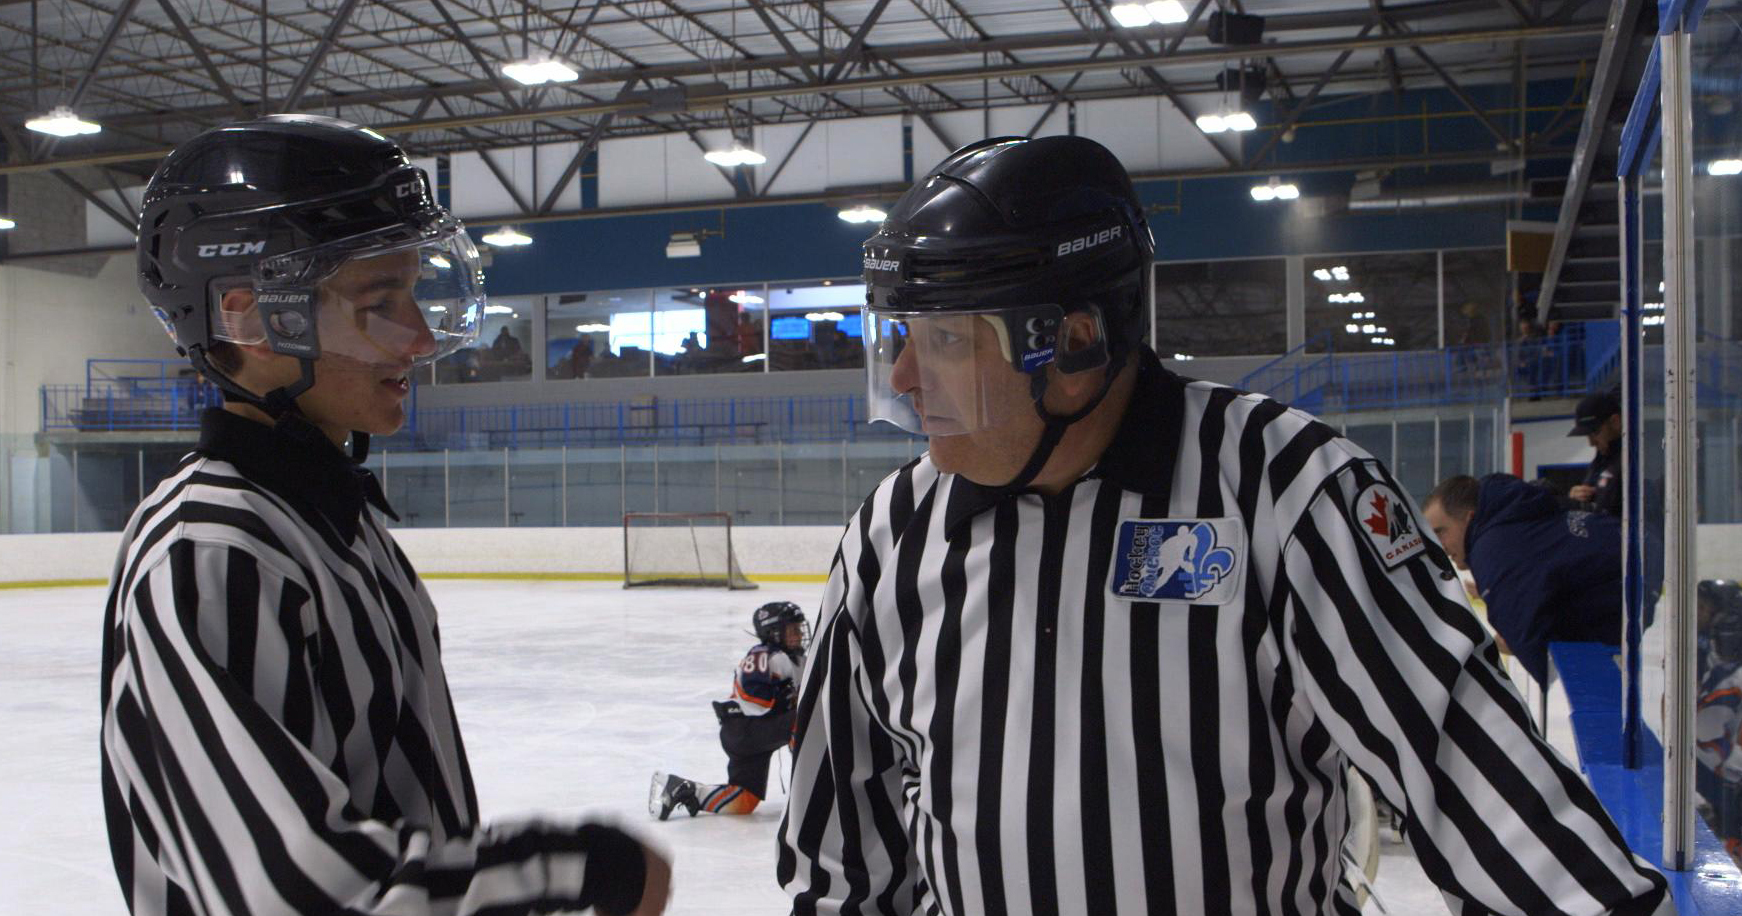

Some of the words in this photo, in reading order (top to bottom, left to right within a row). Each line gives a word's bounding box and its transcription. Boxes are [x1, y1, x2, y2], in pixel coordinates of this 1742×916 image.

[197, 241, 266, 258] CCM
[1057, 226, 1121, 256] BAUER
[864, 258, 900, 271] BAUER
[258, 294, 309, 303] BAUER
[1024, 349, 1054, 361] BAUER
[1124, 525, 1149, 594] Hockey
[744, 652, 768, 673] 80
